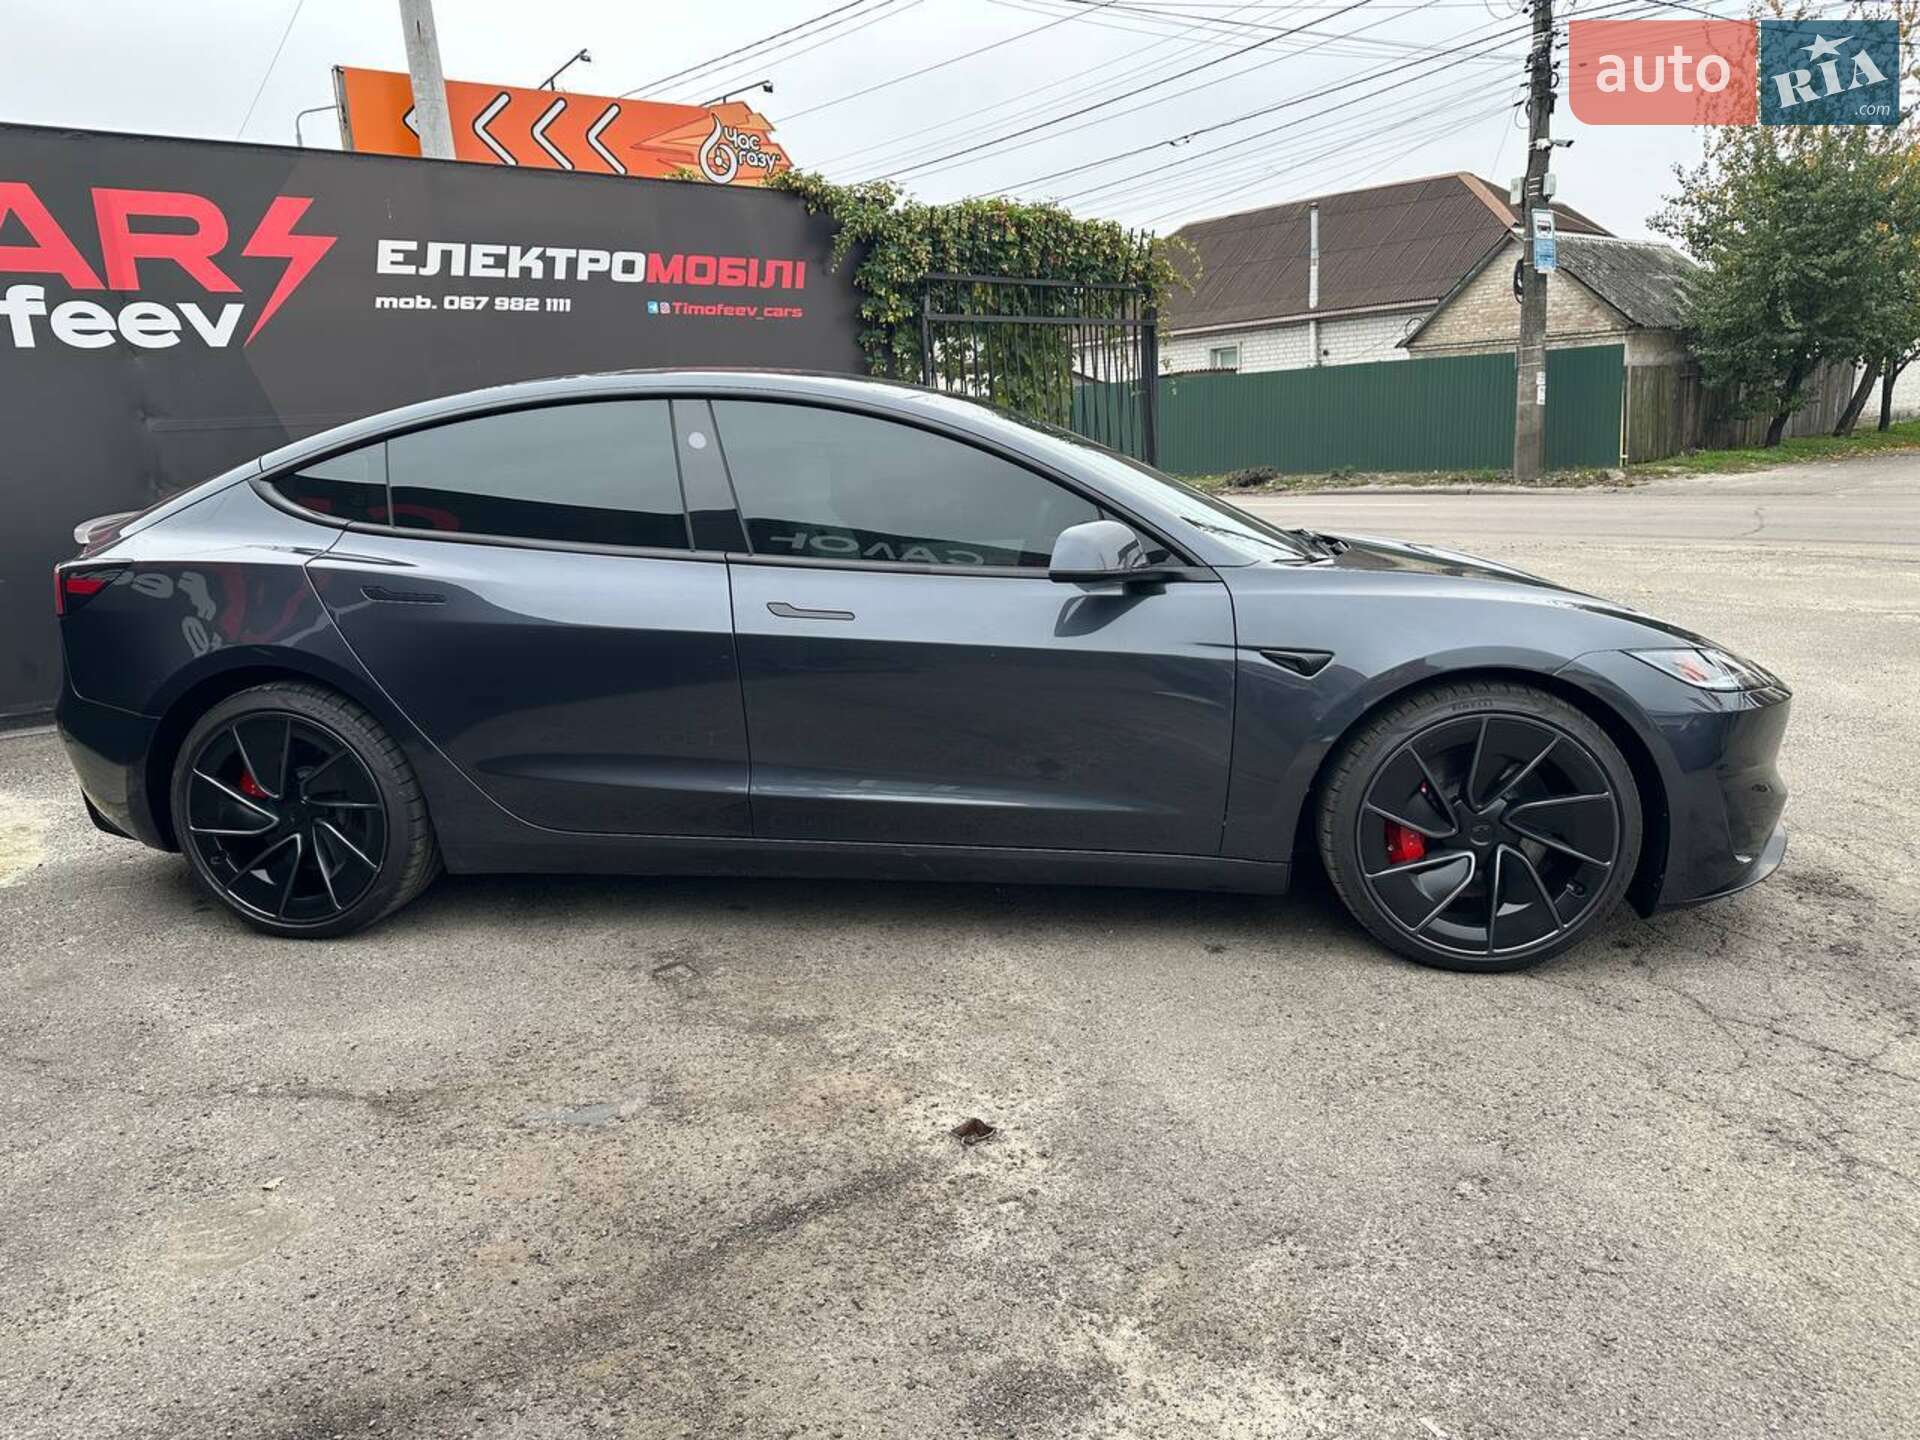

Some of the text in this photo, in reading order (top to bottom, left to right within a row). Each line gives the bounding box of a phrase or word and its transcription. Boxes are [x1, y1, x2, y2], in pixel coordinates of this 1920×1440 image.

[724, 126, 761, 151] Час
[738, 150, 779, 175] газу
[443, 296, 489, 311] 067
[494, 297, 540, 312] 982
[545, 297, 571, 313] 1111
